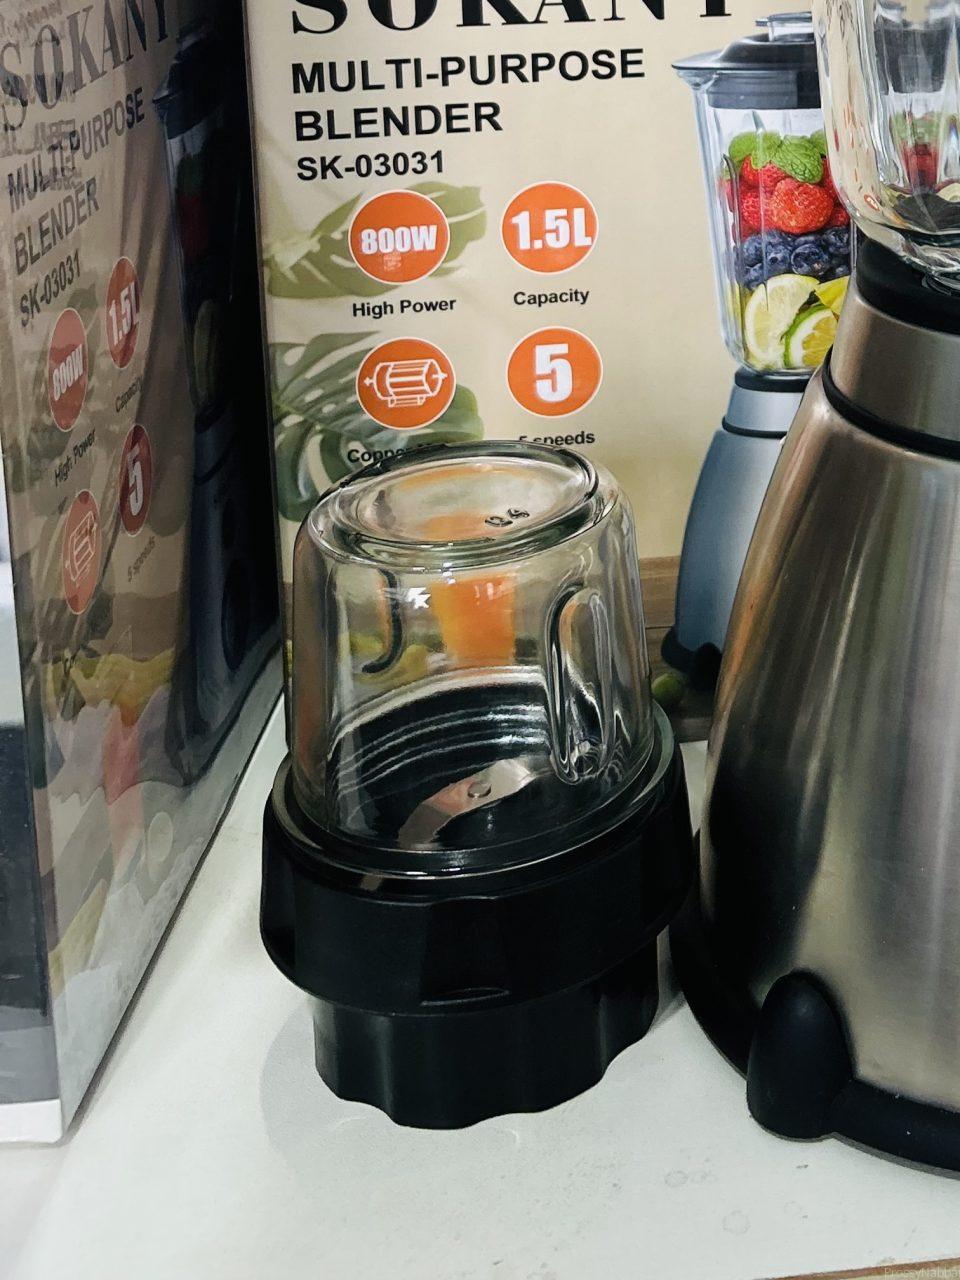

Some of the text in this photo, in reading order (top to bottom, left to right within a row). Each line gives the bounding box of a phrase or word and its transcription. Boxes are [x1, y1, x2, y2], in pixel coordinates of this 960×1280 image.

[291, 48, 646, 94] MULTI-PURPOSE
[294, 101, 503, 142] BLENDER
[296, 150, 444, 181] SK-03031
[13, 176, 101, 277] BLENDER
[360, 224, 438, 255] 800W
[511, 207, 593, 250] 1.5L
[18, 248, 82, 330] SK-03031
[352, 297, 456, 320] High Power
[513, 288, 590, 308] Capacity
[534, 343, 573, 403] 5
[126, 442, 144, 517] 5
